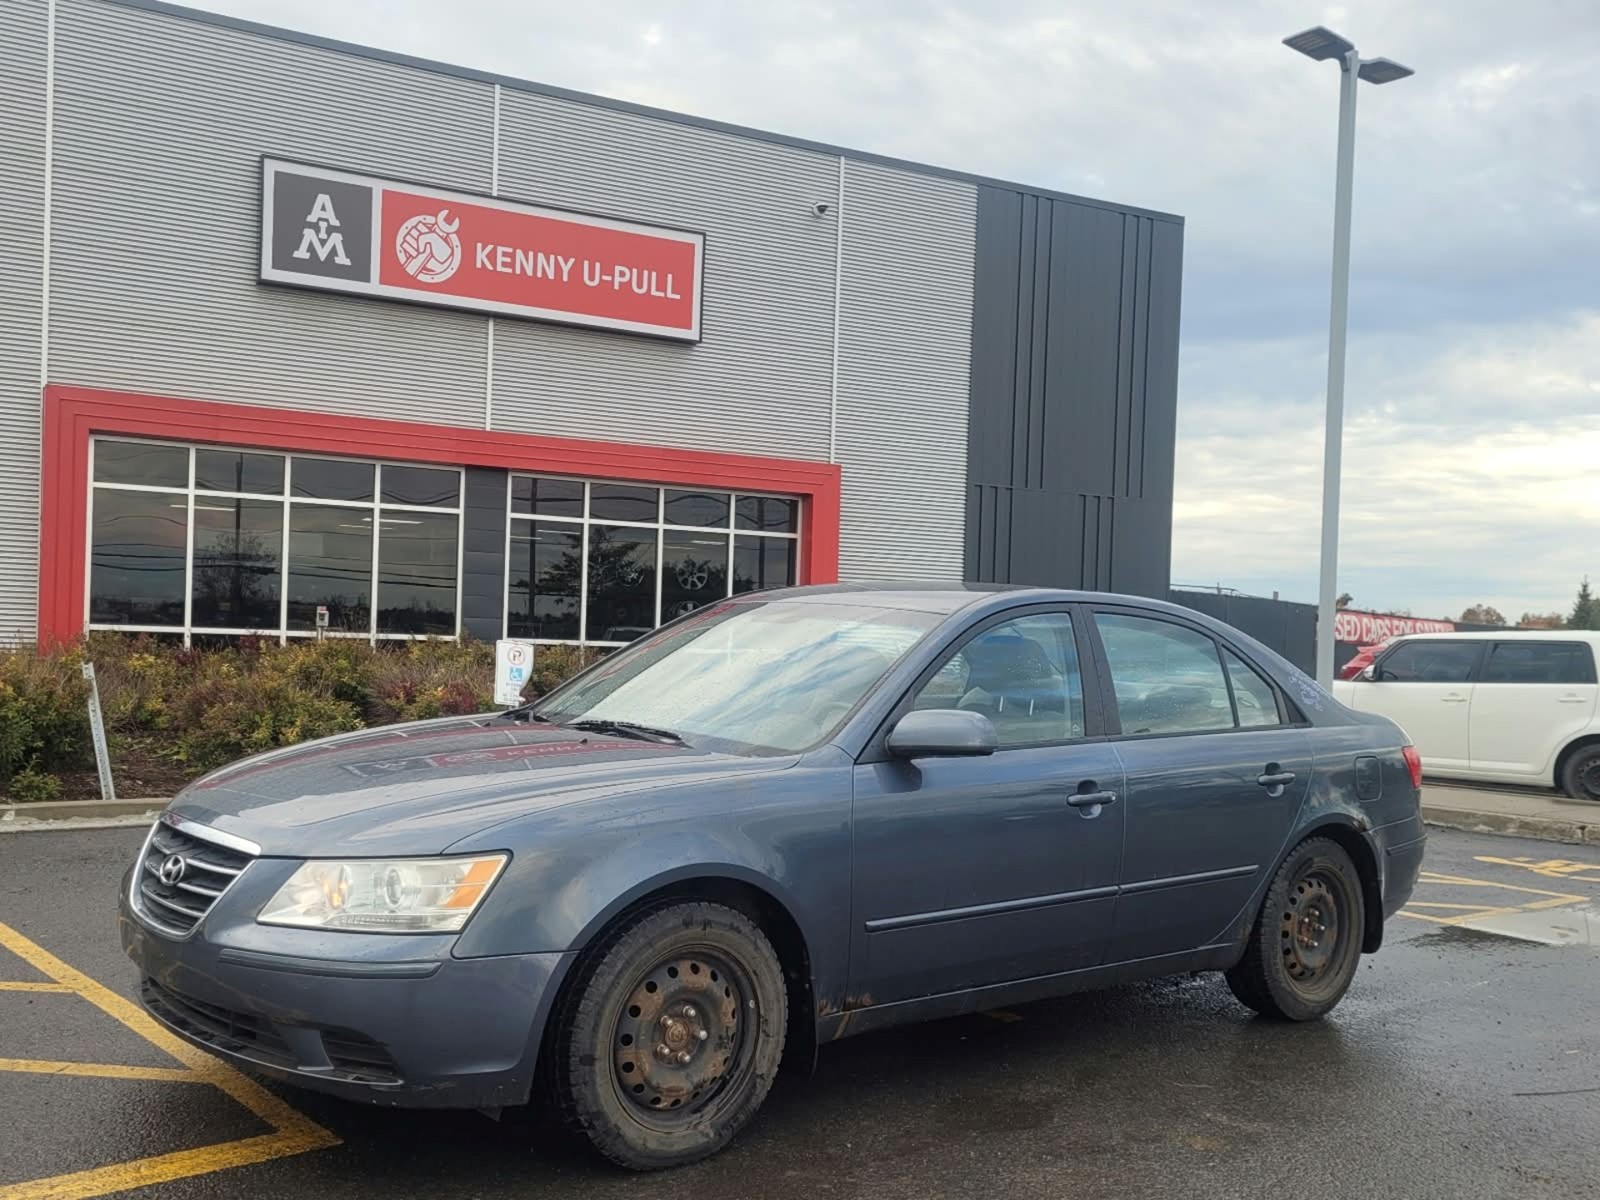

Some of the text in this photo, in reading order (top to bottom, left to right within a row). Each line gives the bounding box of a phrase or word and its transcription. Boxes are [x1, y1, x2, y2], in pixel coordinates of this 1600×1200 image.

[293, 193, 352, 266] AIM
[475, 242, 681, 300] KENNY U-PULL
[1334, 613, 1360, 641] SED
[1362, 617, 1392, 643] CARS
